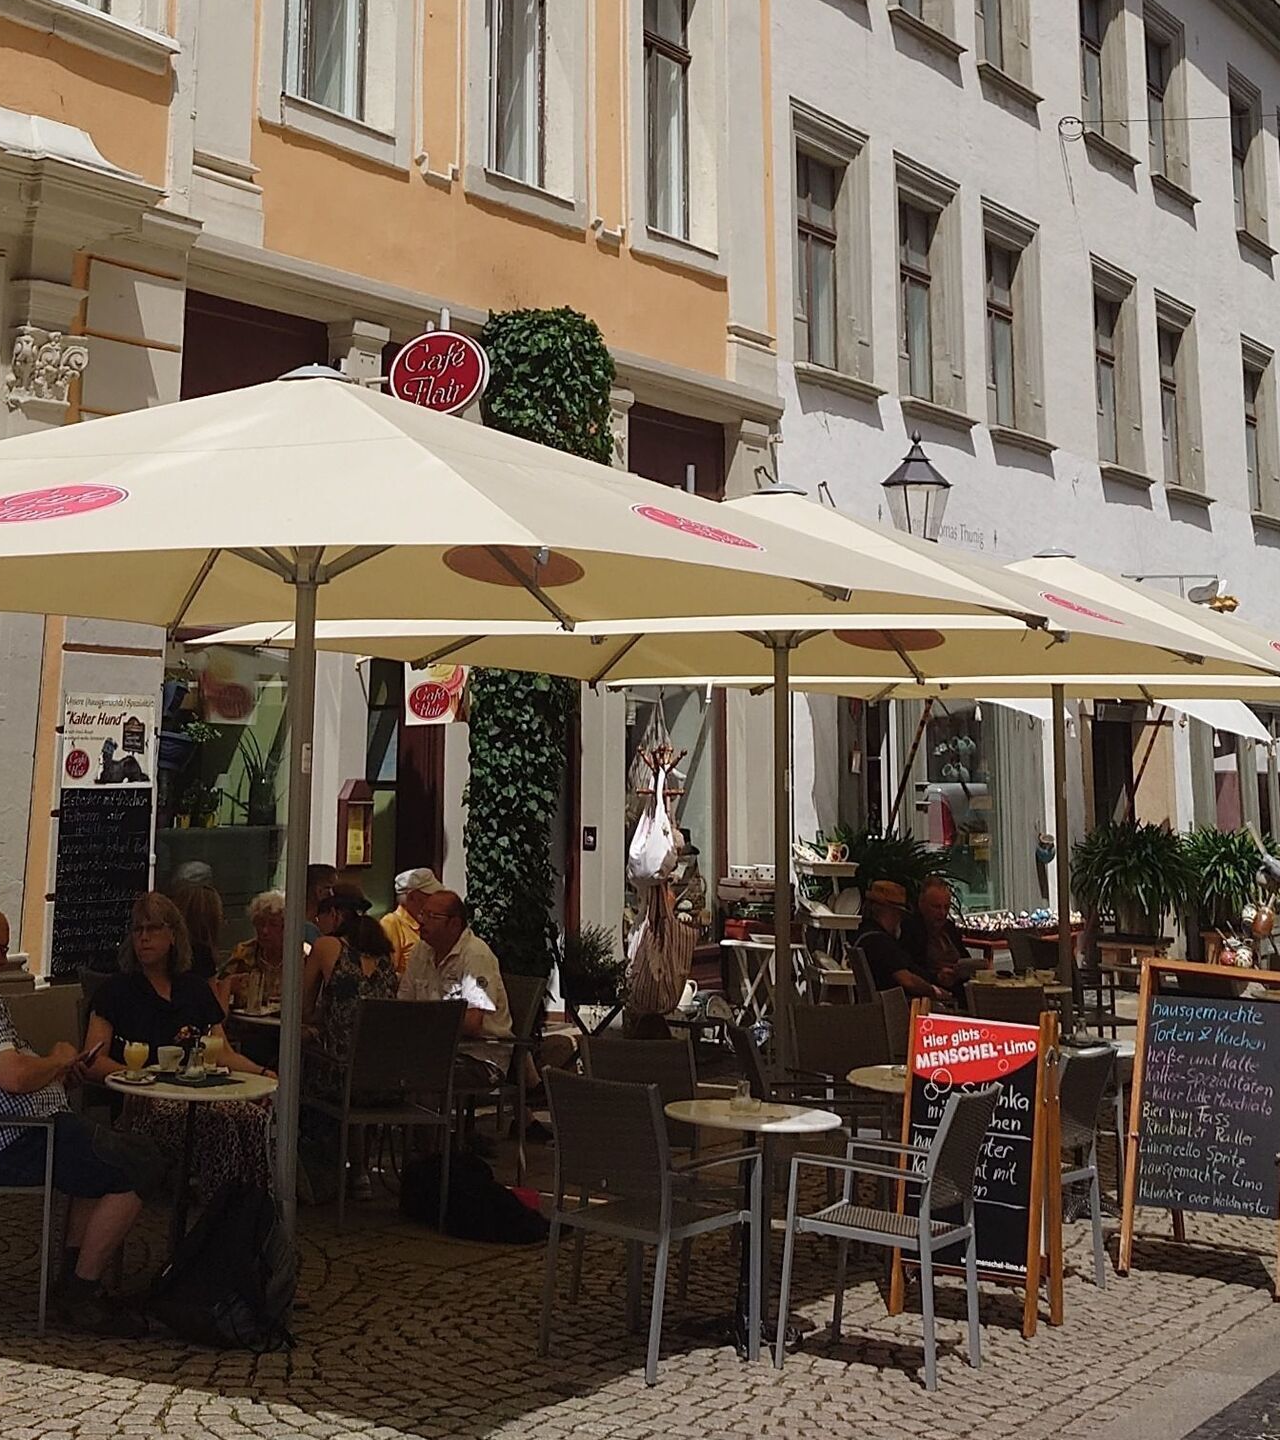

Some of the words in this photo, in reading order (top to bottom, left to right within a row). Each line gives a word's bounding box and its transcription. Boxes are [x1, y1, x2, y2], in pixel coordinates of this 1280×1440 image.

[405, 341, 466, 377] Café
[403, 375, 465, 406] Flair
[960, 523, 984, 550] Thunig
[415, 686, 446, 703] Café
[414, 701, 445, 717] Flair
[1152, 998, 1265, 1025] hausgemachte
[923, 1033, 949, 1048] Hier
[951, 1028, 980, 1047] gibts
[1150, 1019, 1195, 1043] Torten
[1214, 1025, 1267, 1051] Kuchen
[915, 1039, 1037, 1070] MENSCHEL-Limo
[1147, 1044, 1185, 1065] heiße
[1189, 1052, 1218, 1067] und
[927, 1100, 950, 1119] mi
[1142, 1101, 1163, 1118] Bier
[1169, 1107, 1193, 1121] vom
[1138, 1136, 1201, 1158] Limoncello
[992, 1162, 1017, 1185] mit
[1139, 1158, 1227, 1186] hausgemachte
[1231, 1170, 1264, 1192] Limo
